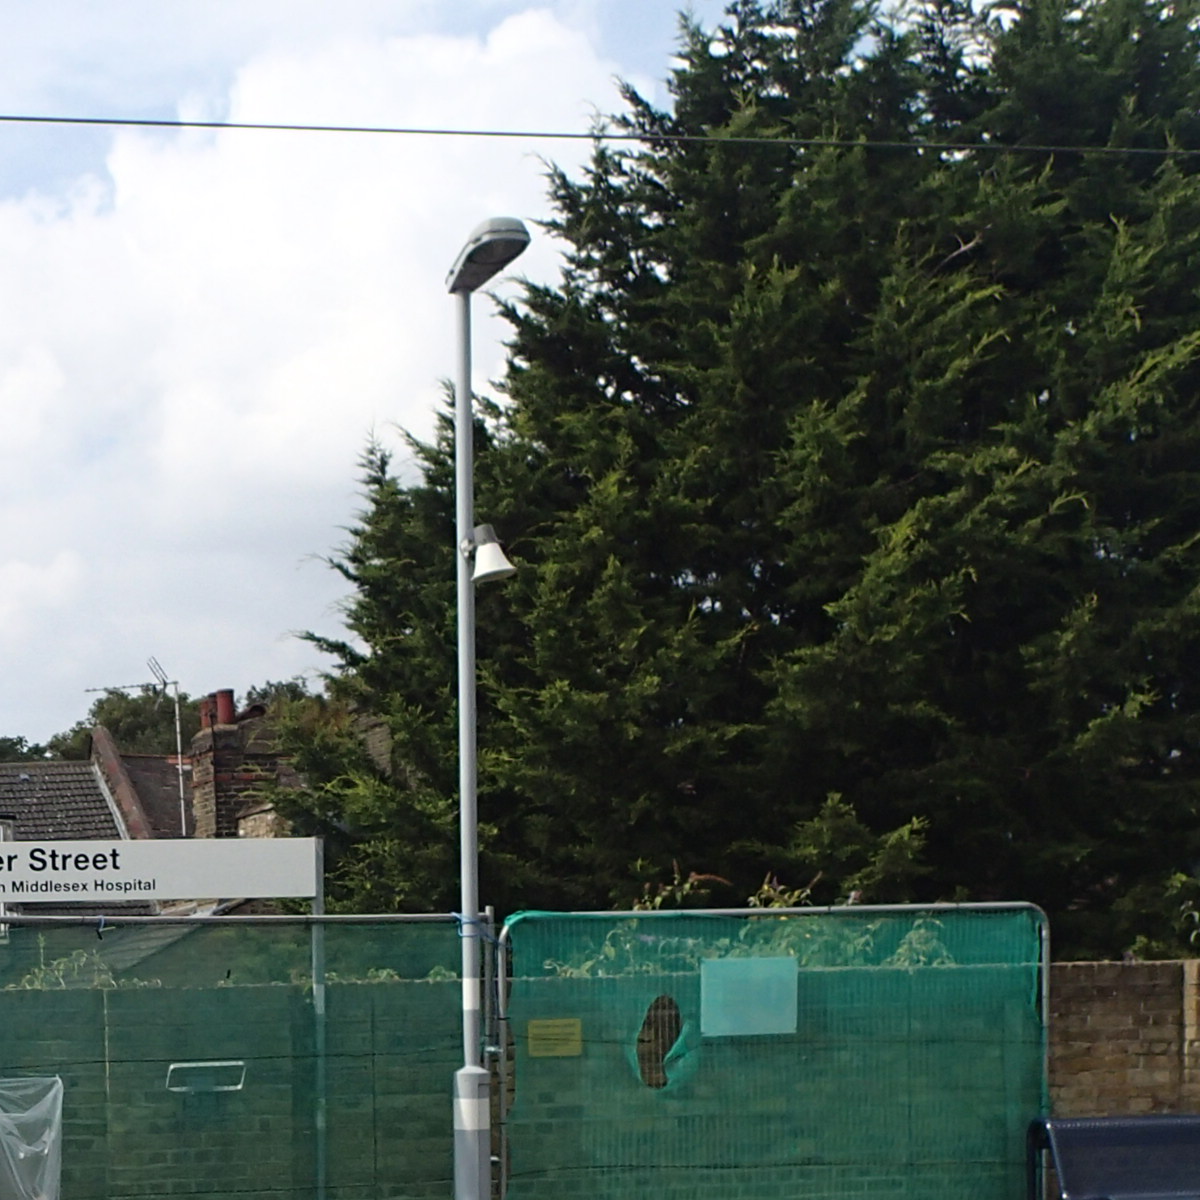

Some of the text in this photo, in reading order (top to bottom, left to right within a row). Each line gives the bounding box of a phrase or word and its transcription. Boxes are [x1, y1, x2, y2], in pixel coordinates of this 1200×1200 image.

[28, 847, 121, 871] Street
[12, 879, 89, 893] Middlesex
[94, 878, 156, 894] Hospital
